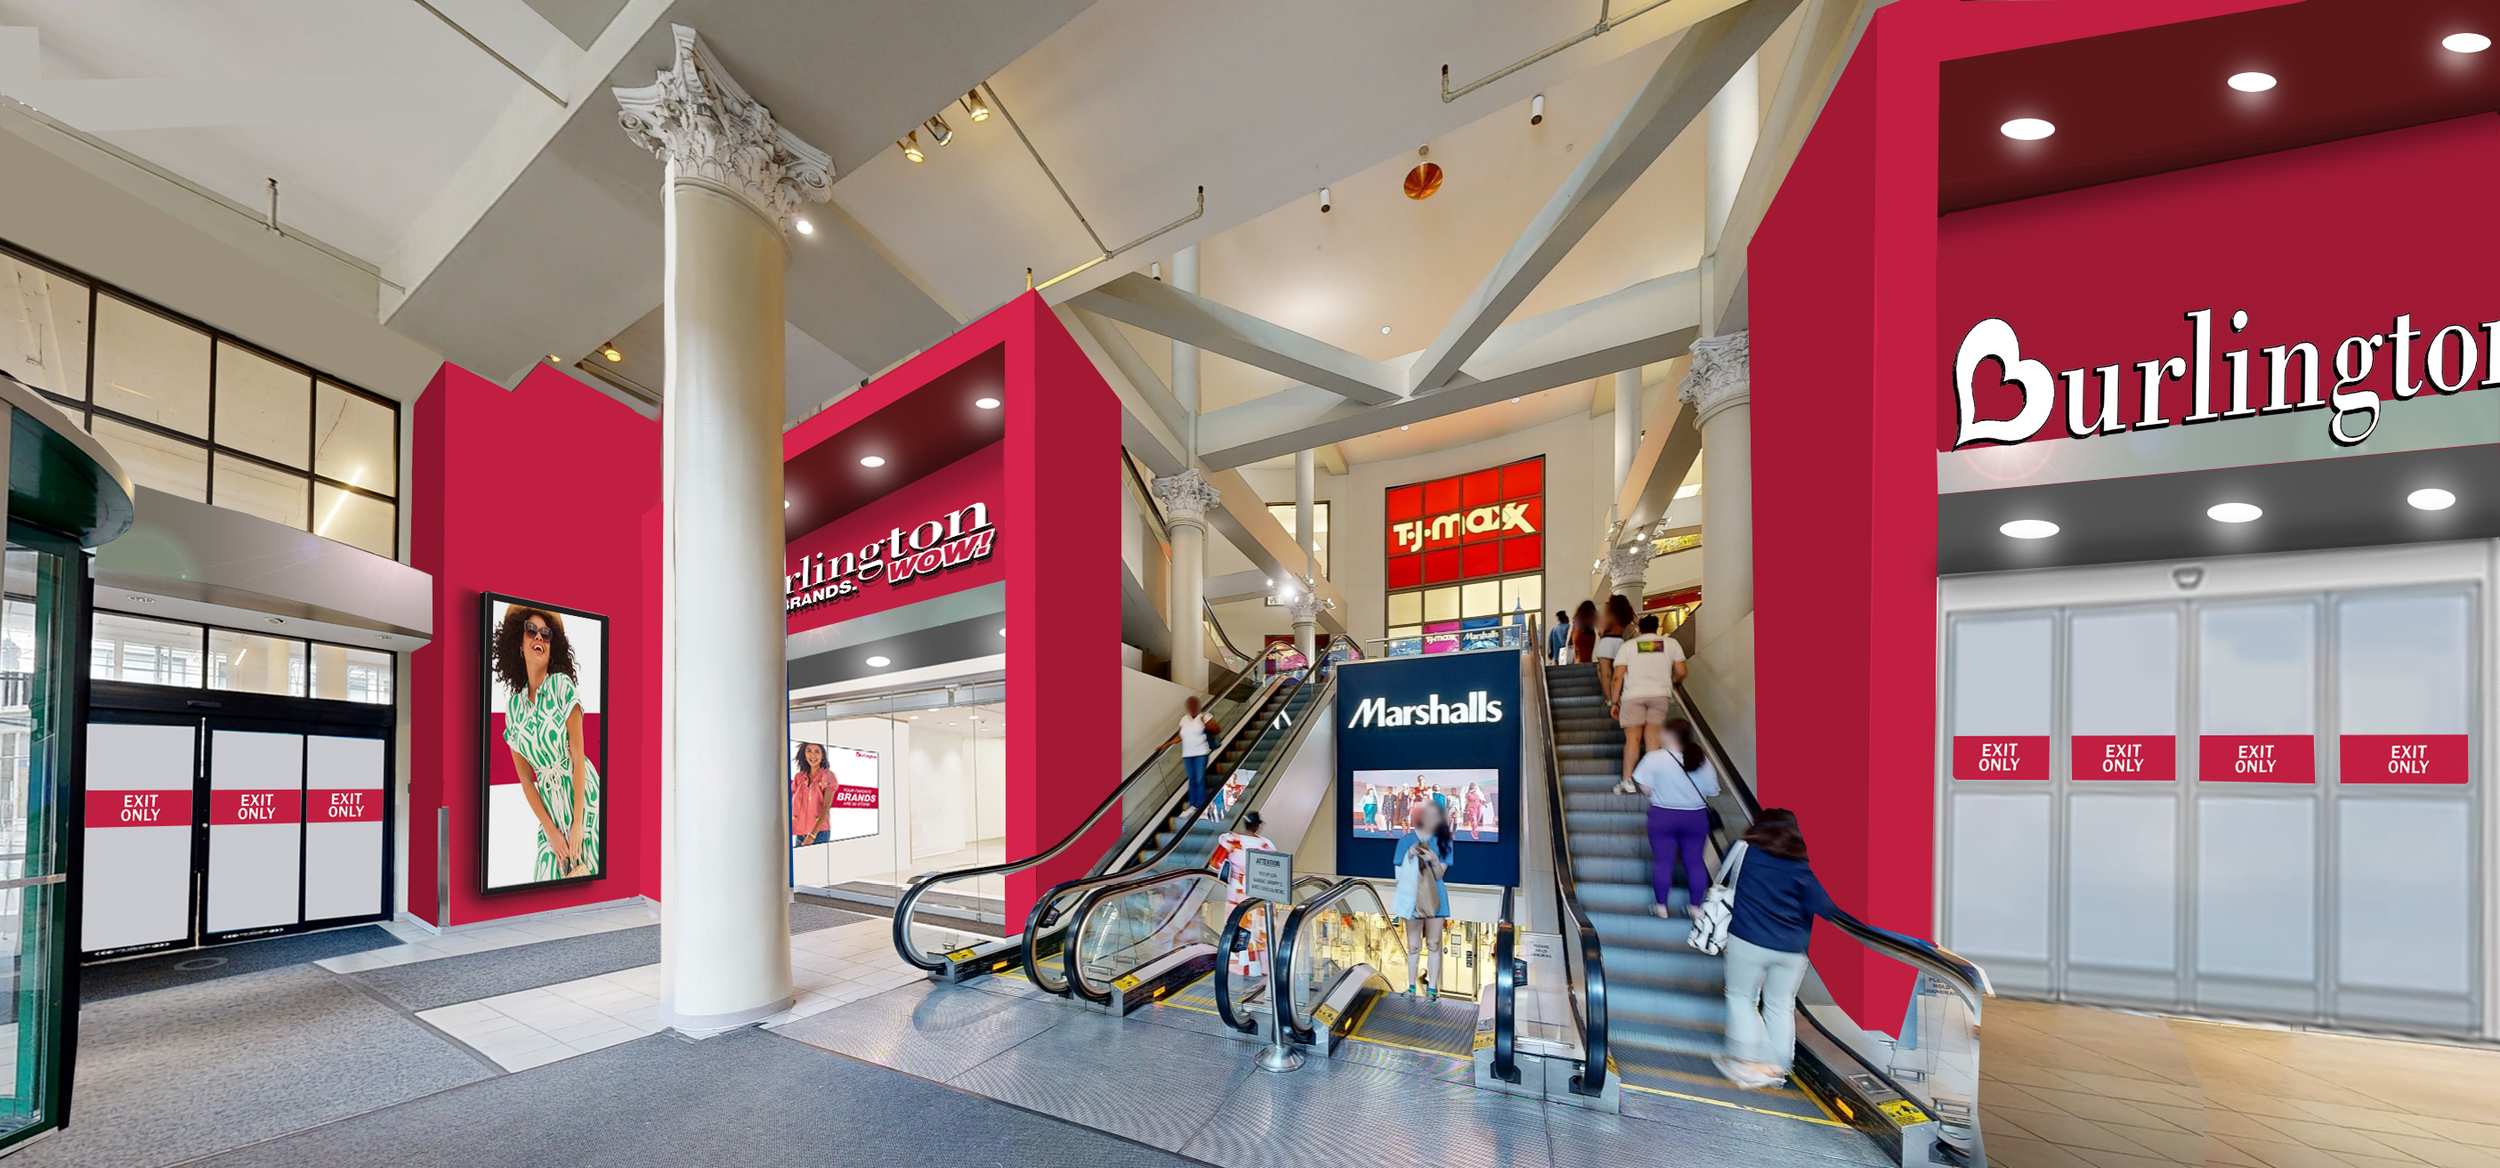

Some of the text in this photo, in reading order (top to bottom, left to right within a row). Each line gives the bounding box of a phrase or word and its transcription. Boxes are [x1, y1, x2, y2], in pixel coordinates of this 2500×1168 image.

[786, 502, 993, 594] rlington
[888, 529, 996, 584] WOW!
[1463, 630, 1499, 641] Marshalls
[1348, 691, 1503, 729] Marshalls
[1982, 743, 2018, 757] EXIT
[2106, 743, 2142, 757] EXIT
[2238, 744, 2274, 758] EXIT
[2391, 744, 2427, 759] EXIT
[1979, 758, 2021, 772] ONLY
[2102, 758, 2144, 772] ONLY
[2235, 759, 2277, 773] ONLY
[2388, 760, 2430, 774] ONLY
[124, 794, 159, 807] EXIT
[240, 793, 274, 806] EXIT
[331, 792, 363, 805] EXIT
[837, 792, 876, 803] BRANDS
[120, 808, 161, 822] ONLY
[237, 807, 276, 820] ONLY
[328, 805, 365, 818] ONLY
